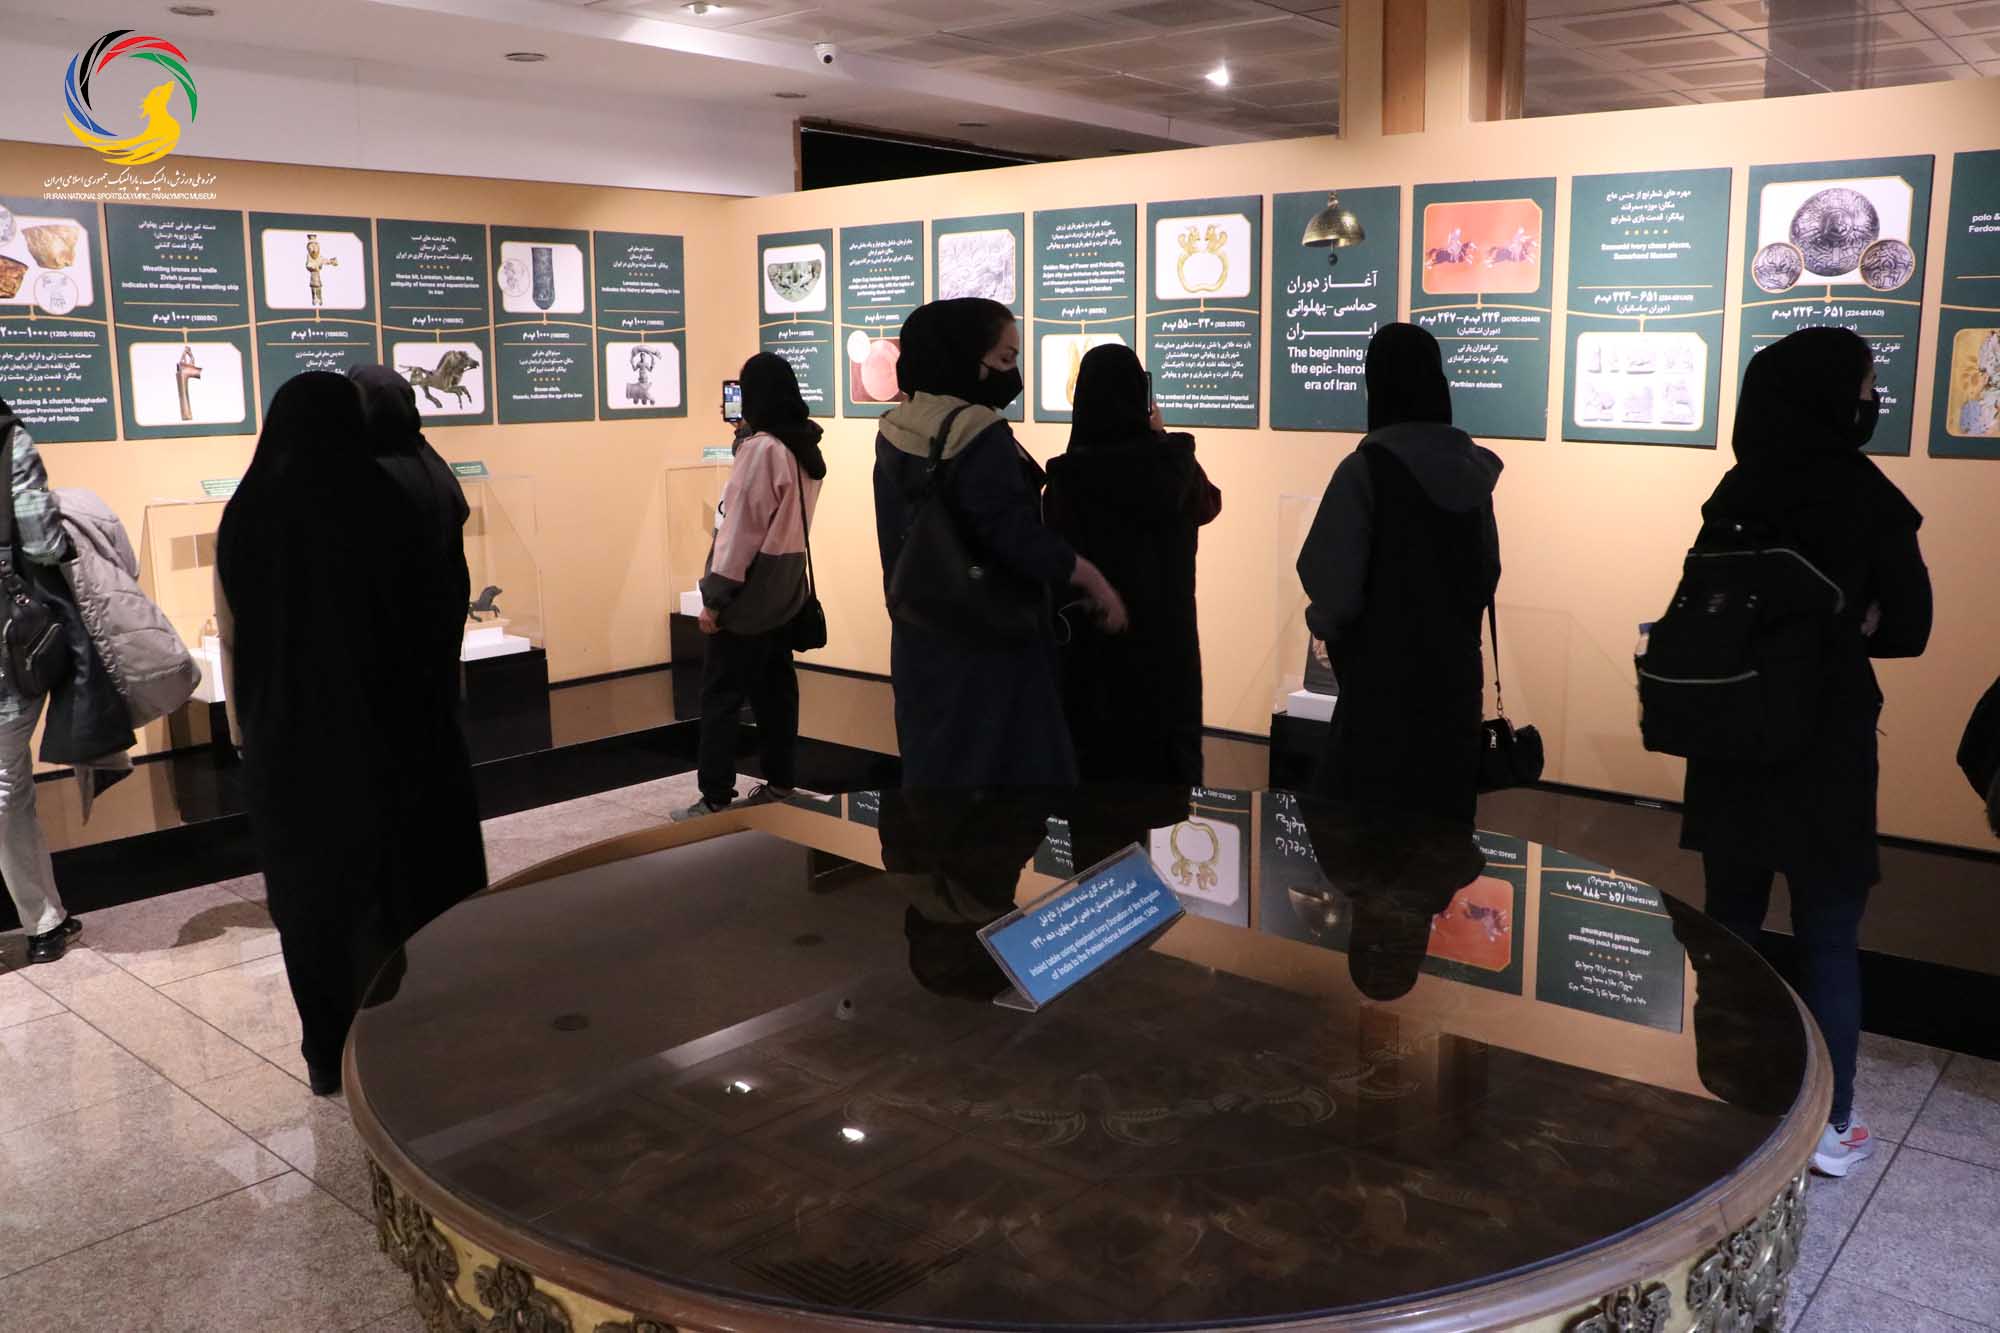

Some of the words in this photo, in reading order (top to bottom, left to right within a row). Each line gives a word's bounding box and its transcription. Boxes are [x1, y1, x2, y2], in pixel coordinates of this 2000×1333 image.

[1972, 214, 1992, 223] polo
[1287, 275, 1320, 294] دوران
[1288, 346, 1308, 358] The
[1309, 346, 1364, 360] beginning
[1291, 363, 1308, 374] the
[1310, 363, 1366, 376] epic-heroi
[1304, 380, 1322, 391] era
[1323, 379, 1336, 391] of
[1336, 380, 1356, 391] Iran
